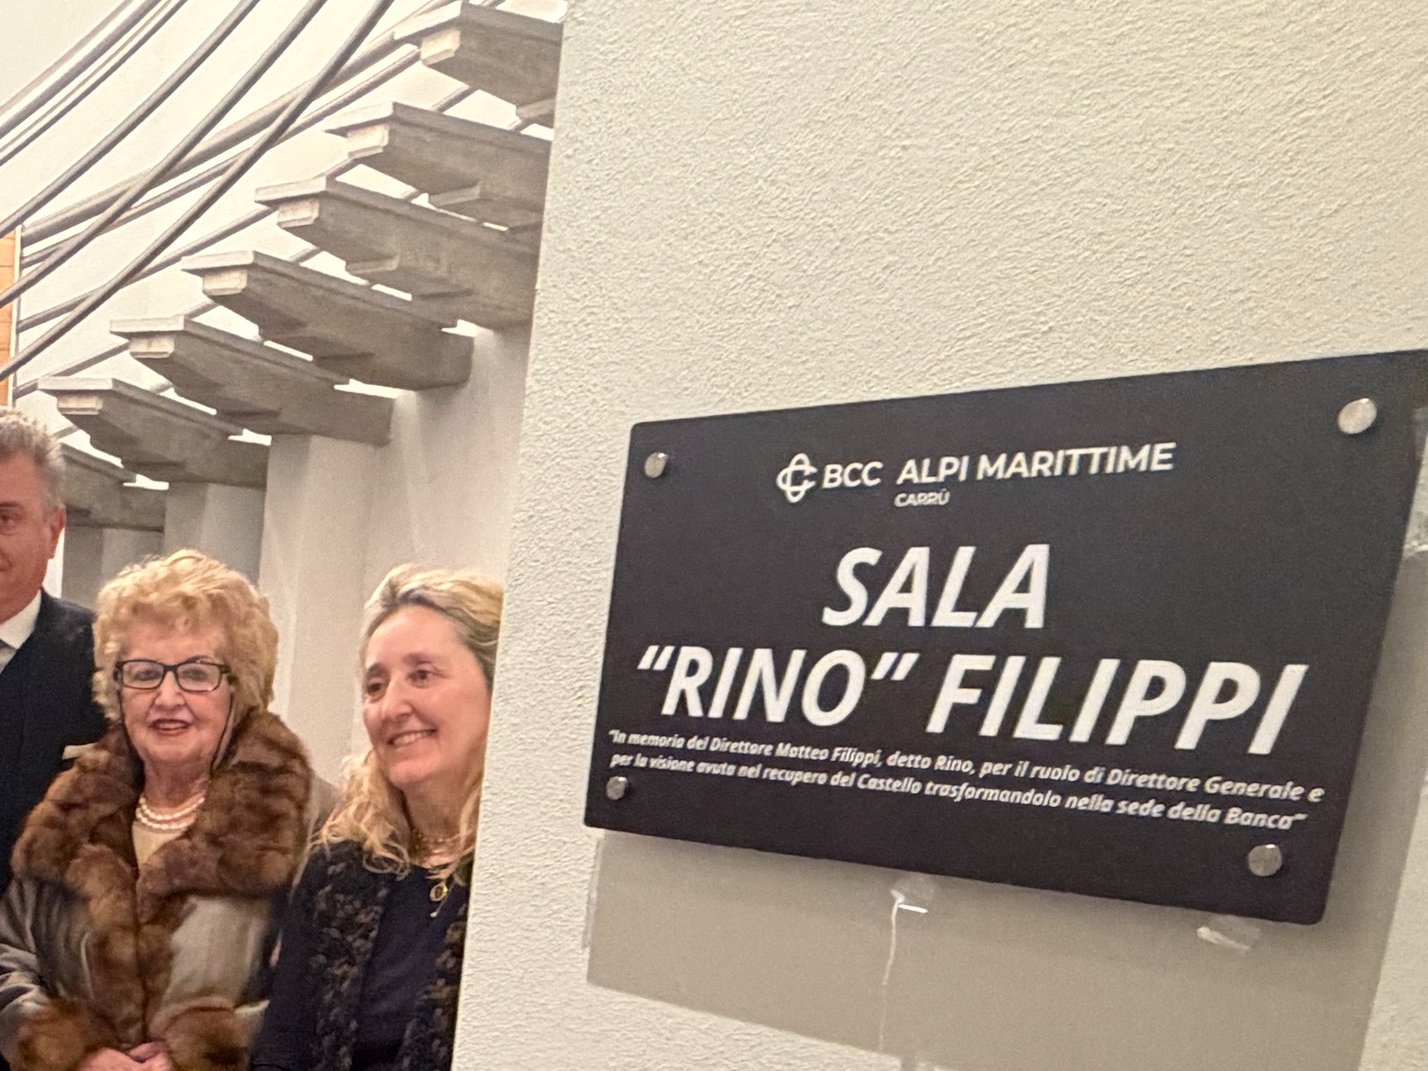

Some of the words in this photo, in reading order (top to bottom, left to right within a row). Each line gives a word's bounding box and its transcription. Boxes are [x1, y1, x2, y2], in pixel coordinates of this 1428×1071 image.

[822, 461, 884, 489] BCC
[895, 454, 970, 485] ALPI
[975, 441, 1177, 481] MARITTIME
[820, 542, 1051, 629] SALA
[636, 644, 921, 727] “RINO”
[924, 652, 1310, 755] FILIPPI
[609, 753, 632, 769] per
[633, 753, 648, 768] la
[649, 755, 696, 773] visione
[696, 759, 737, 777] avuta
[737, 763, 762, 779] nel
[762, 767, 829, 787] recupero
[830, 771, 856, 788] del
[856, 773, 923, 795] Castello
[924, 780, 1063, 808] trasformandolo
[1064, 793, 1114, 813] nella
[1115, 798, 1166, 818] sede
[1166, 801, 1222, 823] della
[628, 733, 685, 749] memoria
[686, 734, 709, 750] del
[709, 737, 774, 756] Direttore
[774, 742, 830, 761] Matteo
[830, 746, 883, 769] Filippi,
[886, 750, 932, 769] detto
[934, 754, 976, 776] Rino,
[978, 761, 1013, 778] per
[1014, 760, 1030, 777] il
[1030, 764, 1081, 782] ruolo
[1083, 766, 1106, 784] di
[1106, 768, 1202, 792] Direttore
[1204, 776, 1306, 801] Generale
[1307, 787, 1326, 803] e
